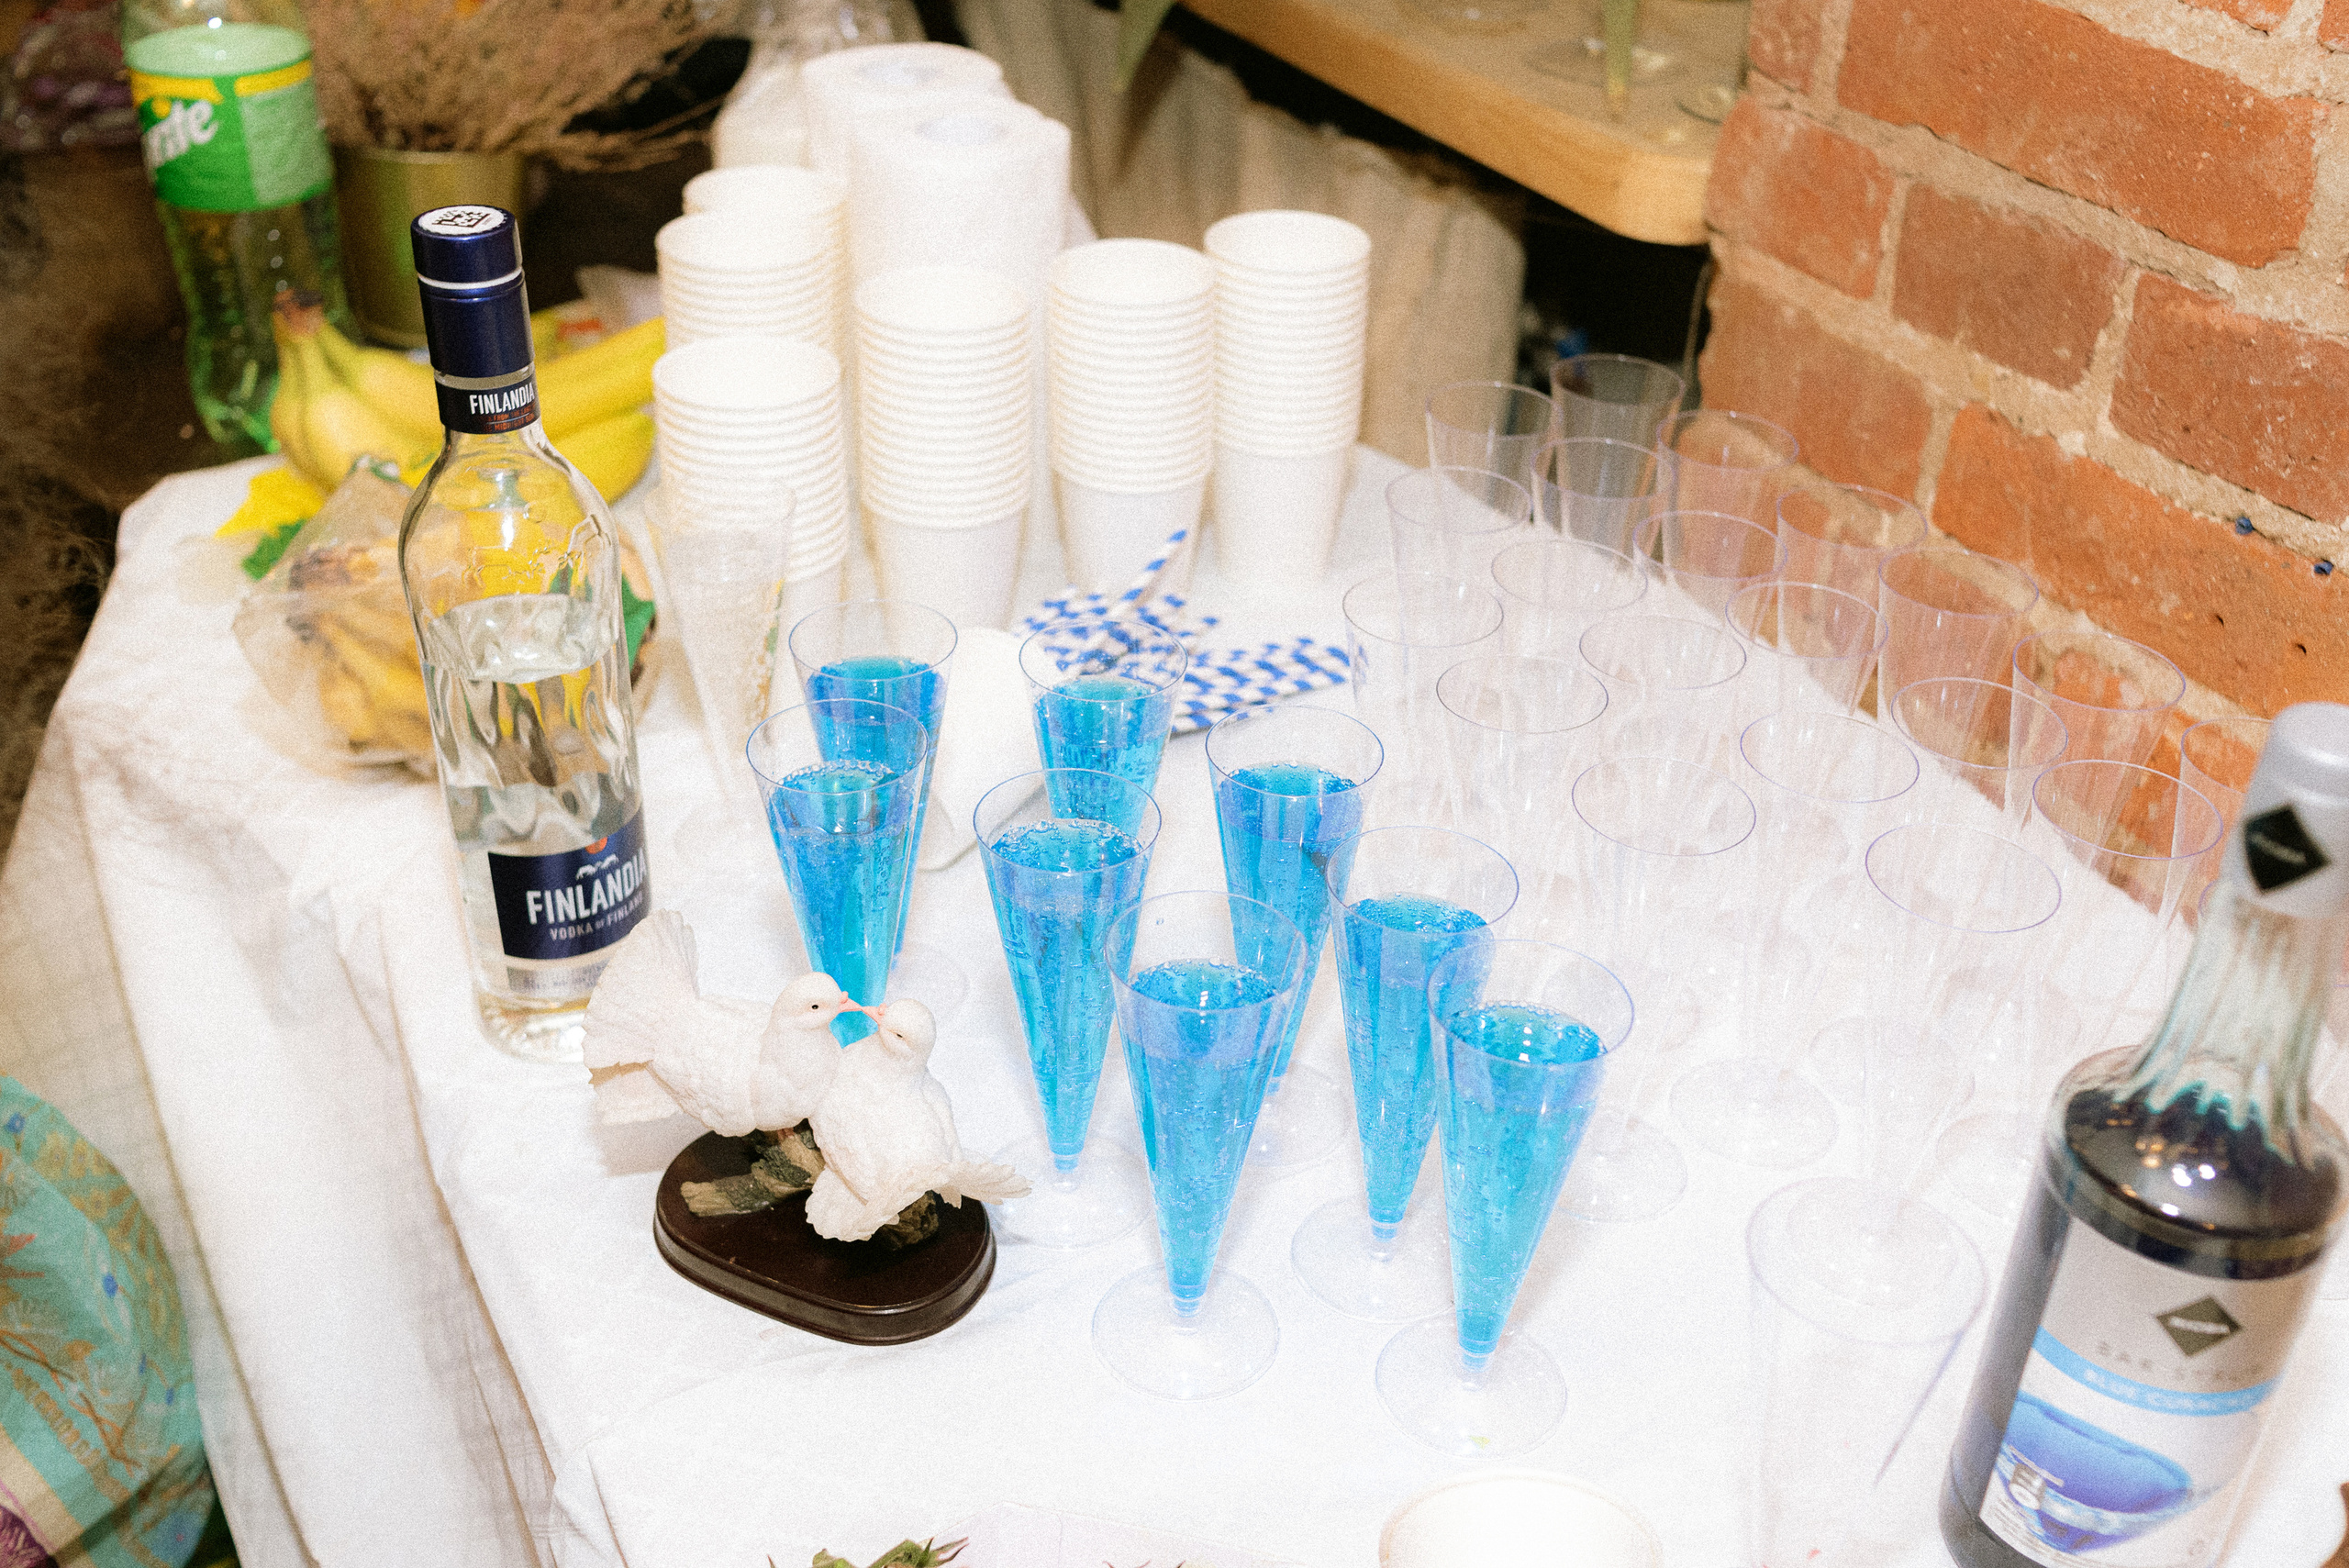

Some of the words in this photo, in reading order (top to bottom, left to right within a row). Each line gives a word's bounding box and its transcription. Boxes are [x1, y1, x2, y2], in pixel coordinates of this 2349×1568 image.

[469, 382, 535, 415] FINLANDIA
[525, 848, 648, 925] FINLANDIA
[550, 922, 594, 941] VODKA
[2083, 1368, 2137, 1400] BLUE
